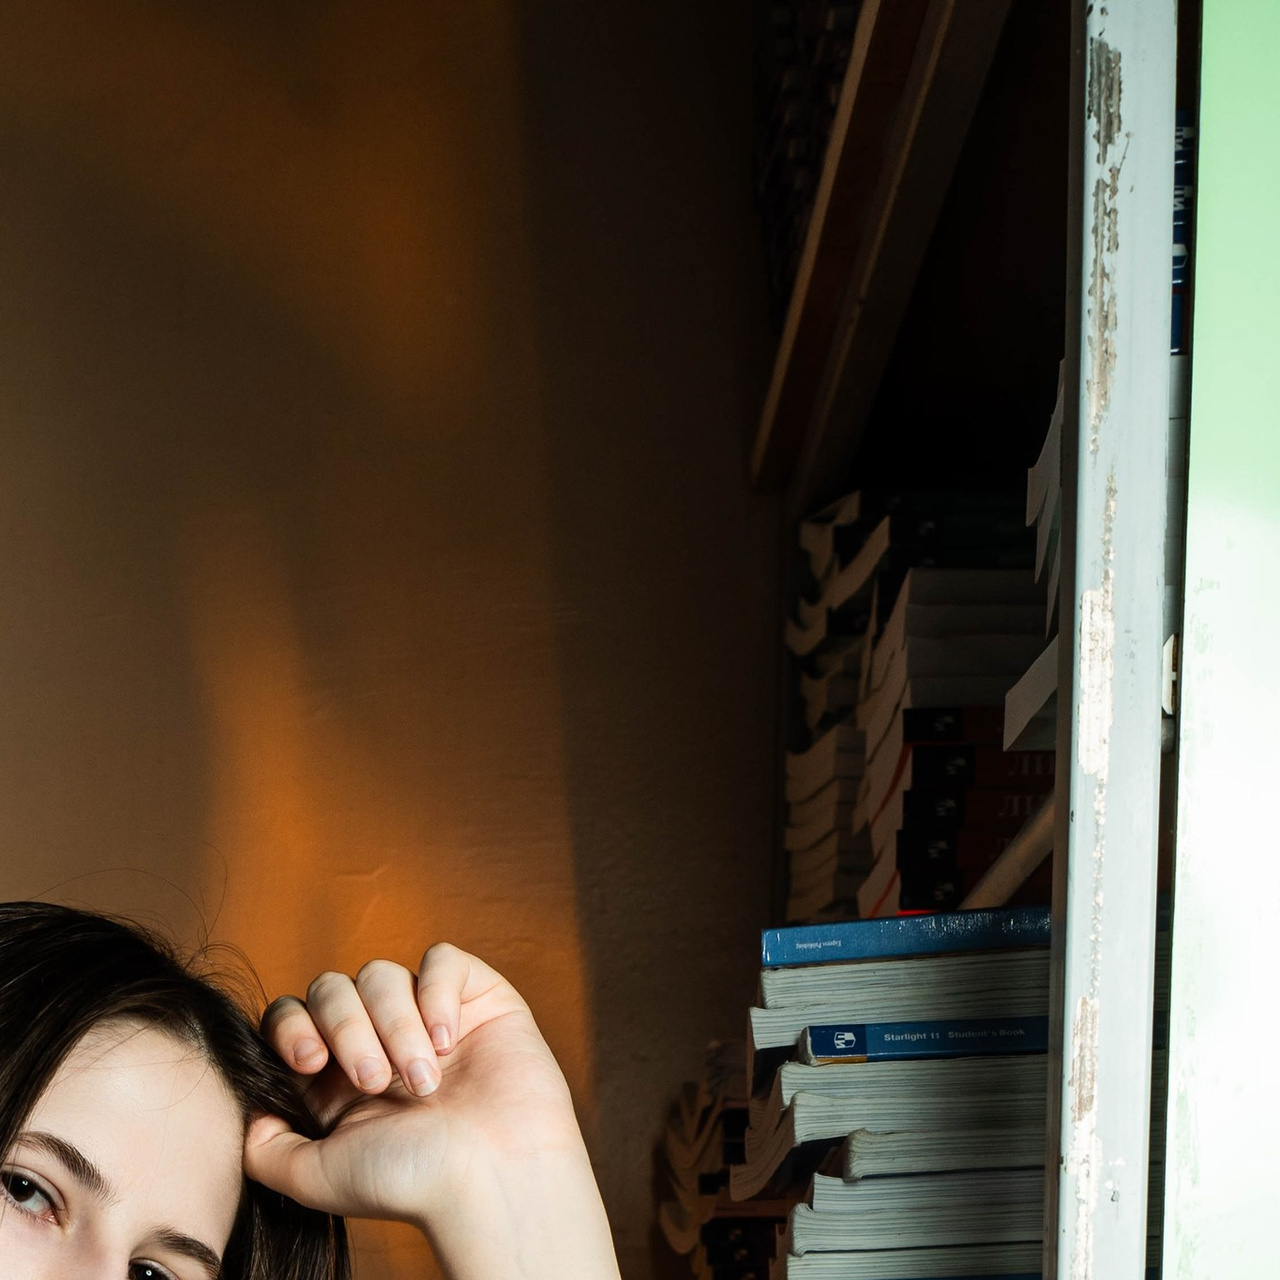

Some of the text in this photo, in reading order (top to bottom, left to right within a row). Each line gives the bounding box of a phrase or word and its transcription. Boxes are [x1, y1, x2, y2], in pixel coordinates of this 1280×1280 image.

[883, 1028, 1026, 1042] Starlight 11 Student's Book
